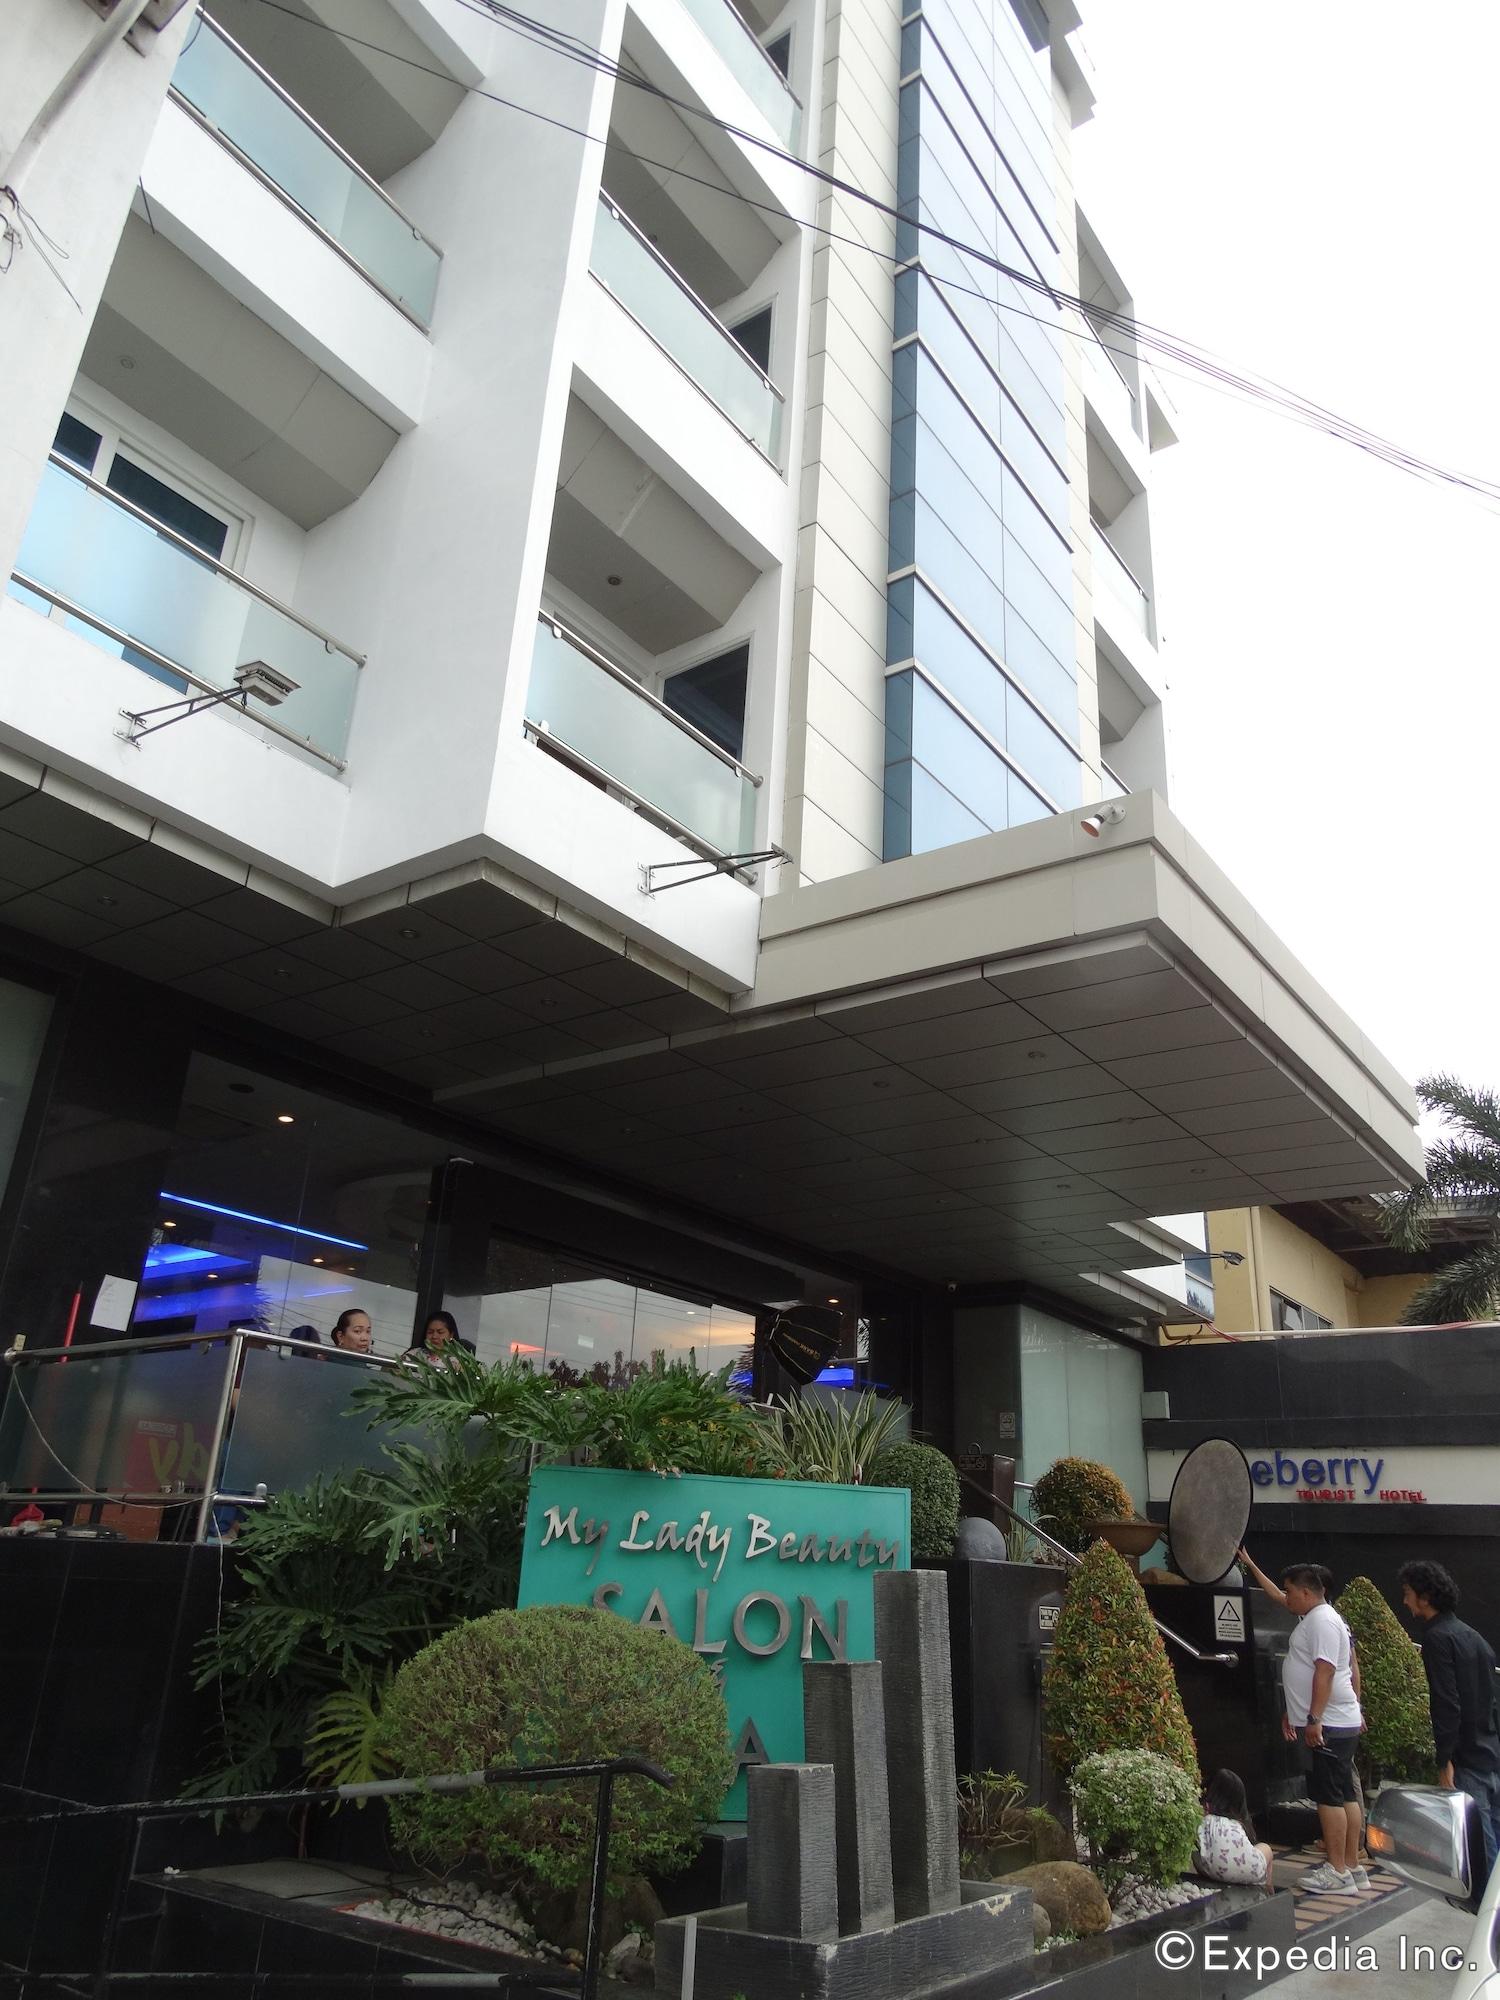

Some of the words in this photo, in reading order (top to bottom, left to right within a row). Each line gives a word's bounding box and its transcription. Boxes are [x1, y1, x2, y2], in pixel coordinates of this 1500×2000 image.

[1296, 1490, 1356, 1501] TOURIST
[1379, 1490, 1427, 1503] HOTEL
[541, 1505, 609, 1576] My
[619, 1510, 732, 1583] Lady
[746, 1513, 900, 1570] Beauty
